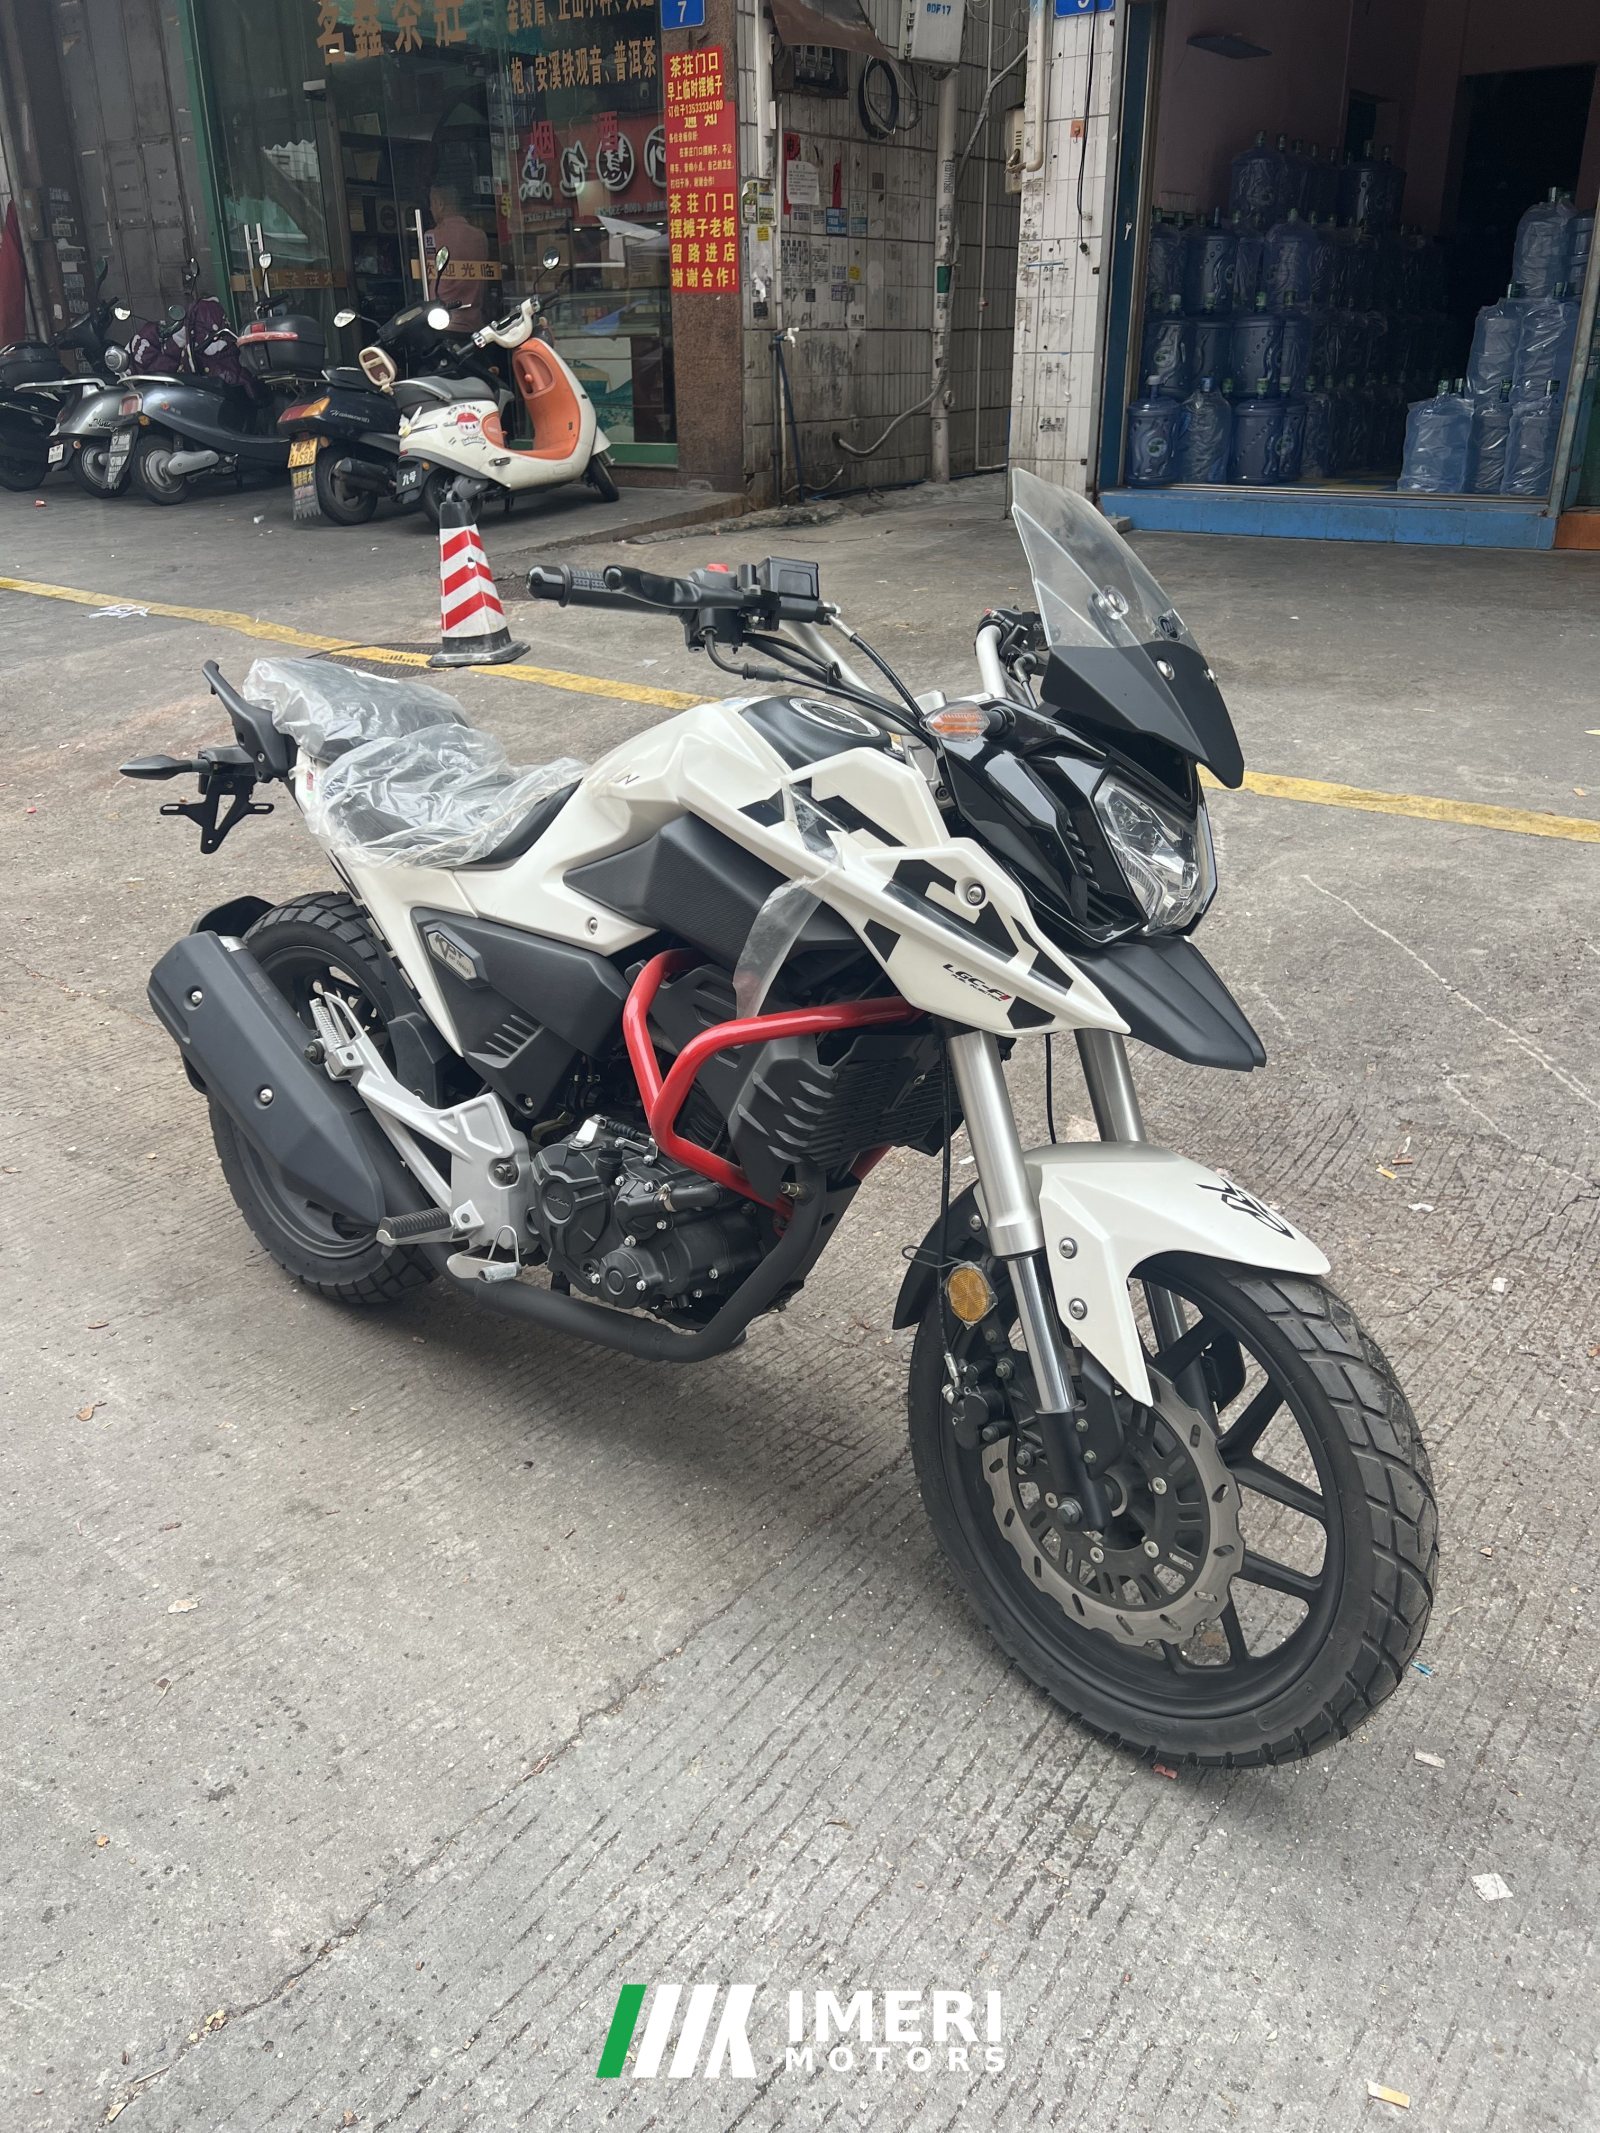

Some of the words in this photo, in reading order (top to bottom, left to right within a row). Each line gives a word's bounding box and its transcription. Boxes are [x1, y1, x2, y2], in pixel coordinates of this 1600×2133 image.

[677, 0, 687, 23] 7
[511, 36, 656, 95] 袍、安溪铁观音、普洱茶
[667, 75, 722, 102] 早上临时摆摊子
[669, 216, 736, 240] 摆摊子老板
[671, 241, 736, 264] 留路进店
[671, 266, 736, 288] 谢谢合作！
[402, 470, 416, 486] 九号
